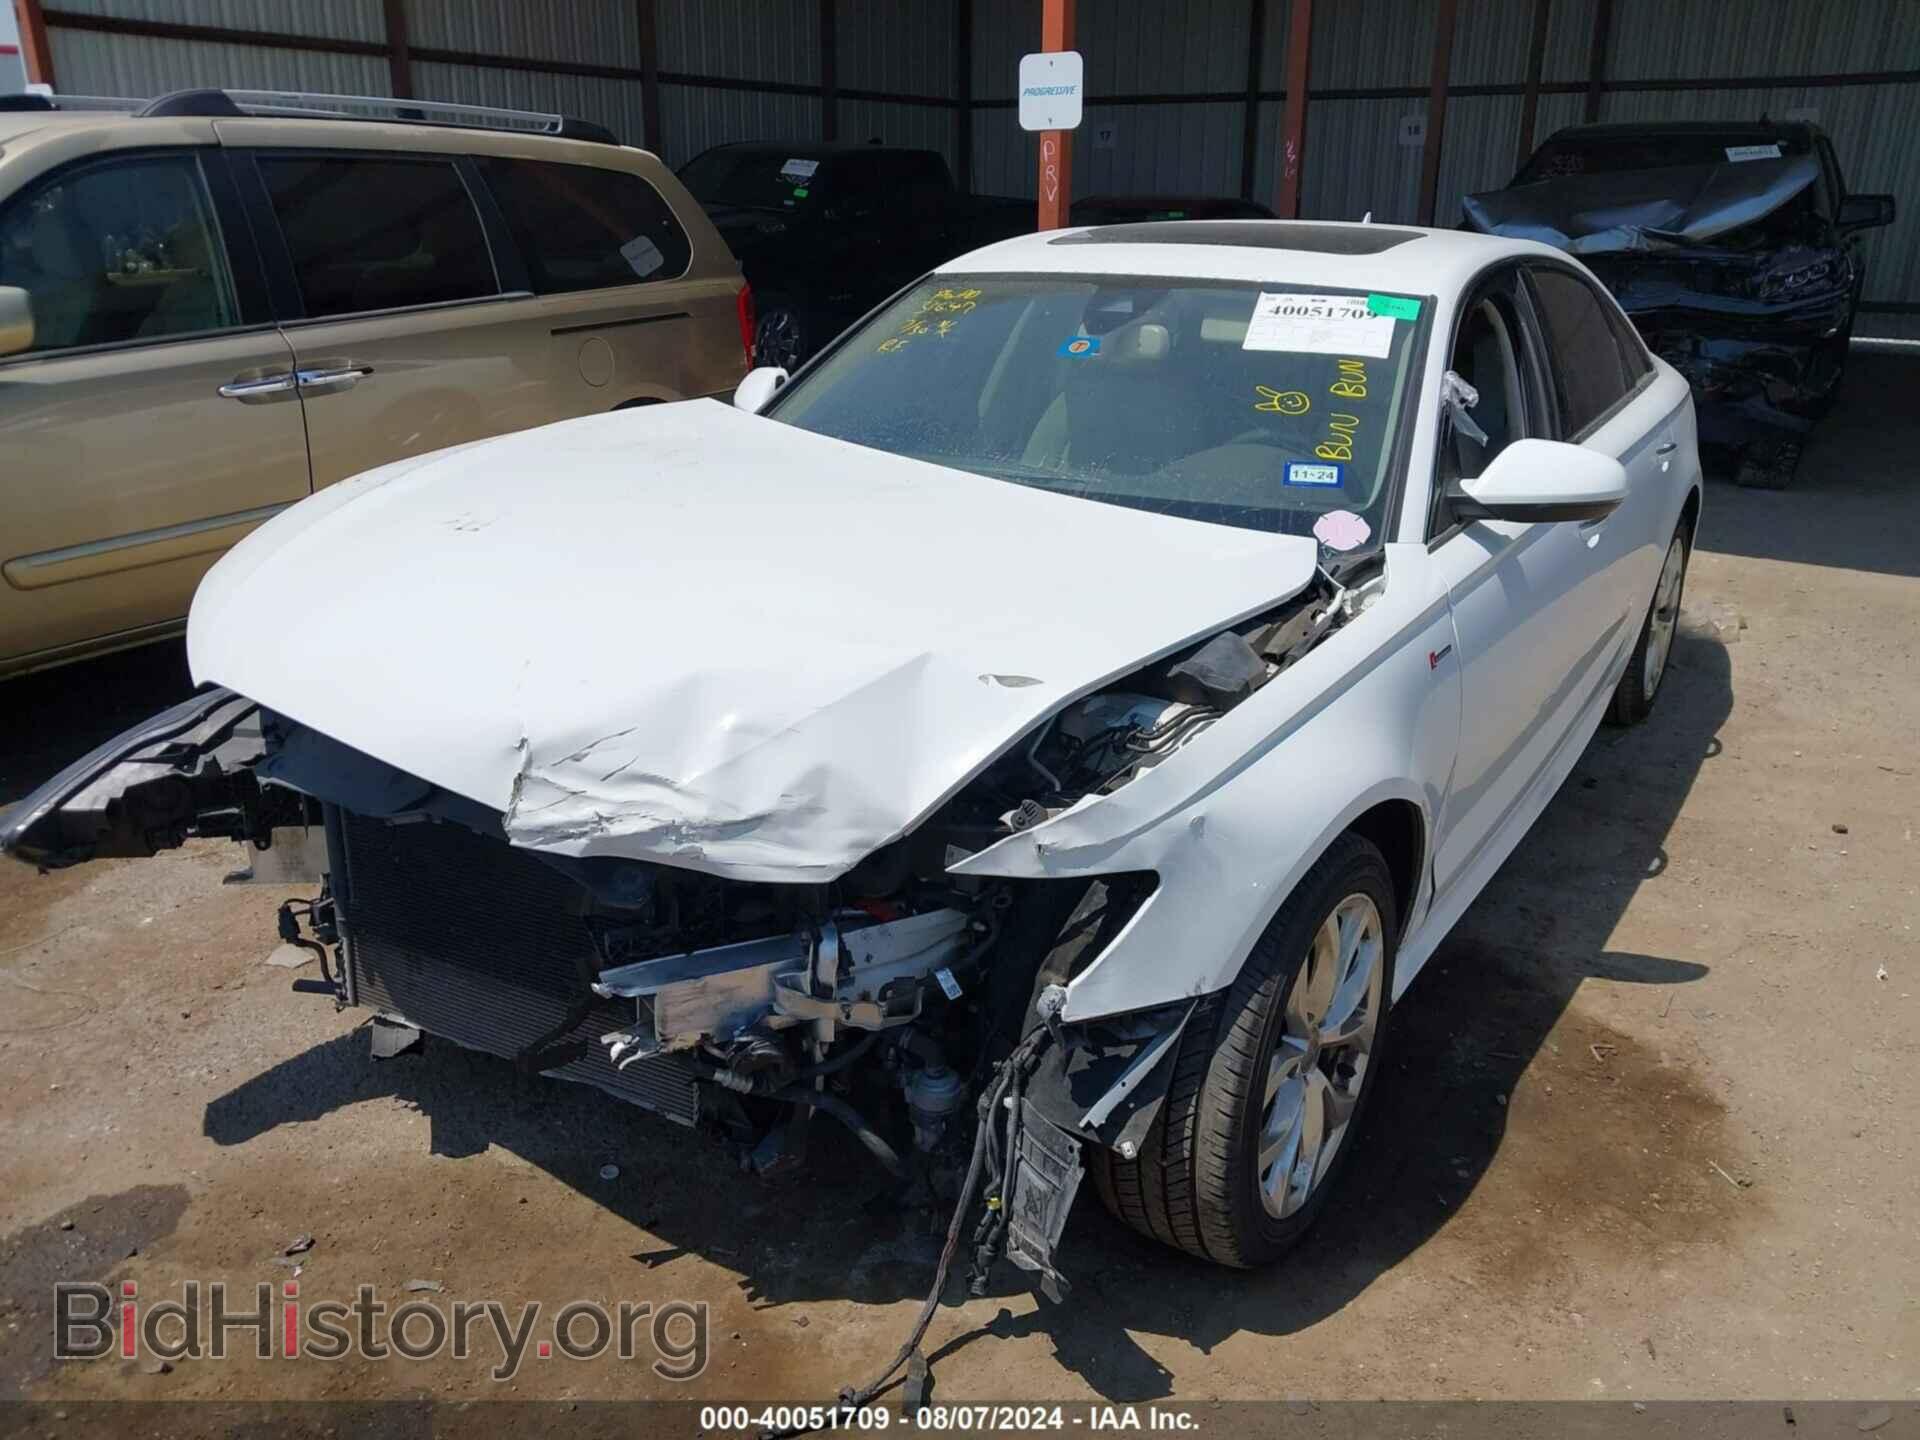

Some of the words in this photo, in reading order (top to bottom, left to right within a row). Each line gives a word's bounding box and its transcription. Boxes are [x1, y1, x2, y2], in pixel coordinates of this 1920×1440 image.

[1023, 85, 1077, 96] PROGRESSIVE
[1100, 130, 1112, 141] 17
[1268, 304, 1379, 320] 40051709
[1330, 359, 1367, 397] BUN
[1315, 412, 1359, 461] BUN
